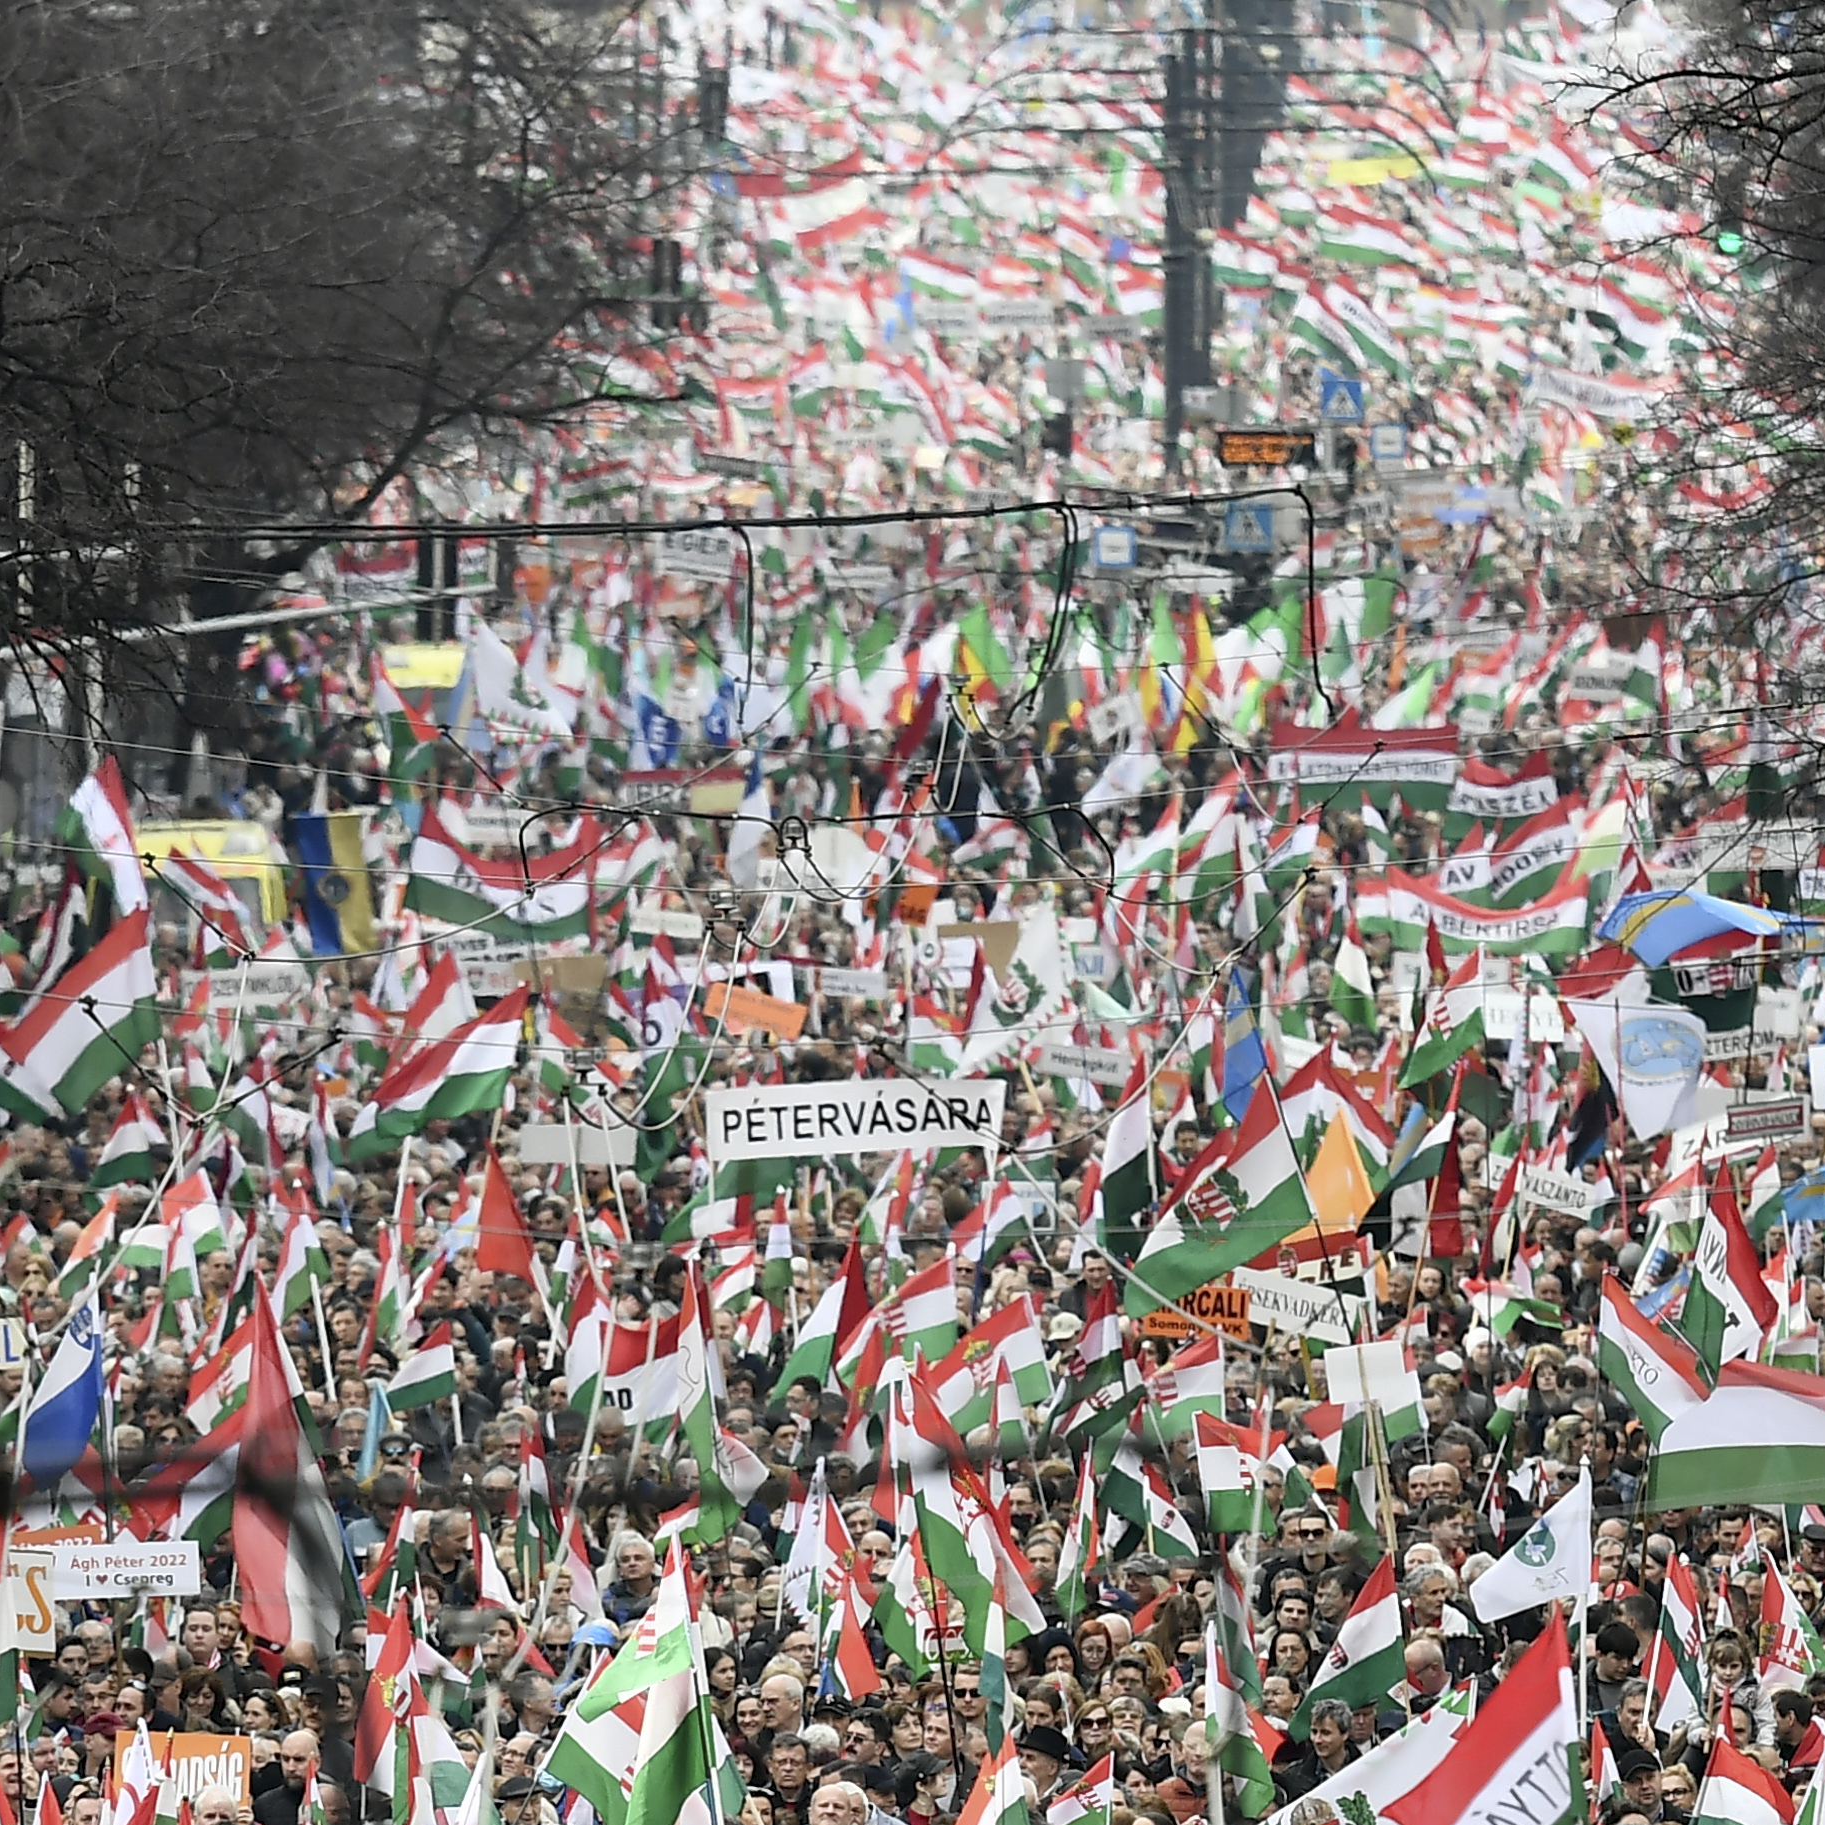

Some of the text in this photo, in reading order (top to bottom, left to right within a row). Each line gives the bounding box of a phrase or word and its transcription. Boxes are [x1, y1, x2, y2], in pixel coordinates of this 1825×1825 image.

[724, 1098, 991, 1144] PÉTERVÁSÁRA
[69, 1553, 187, 1571] Ágh Péter 2022
